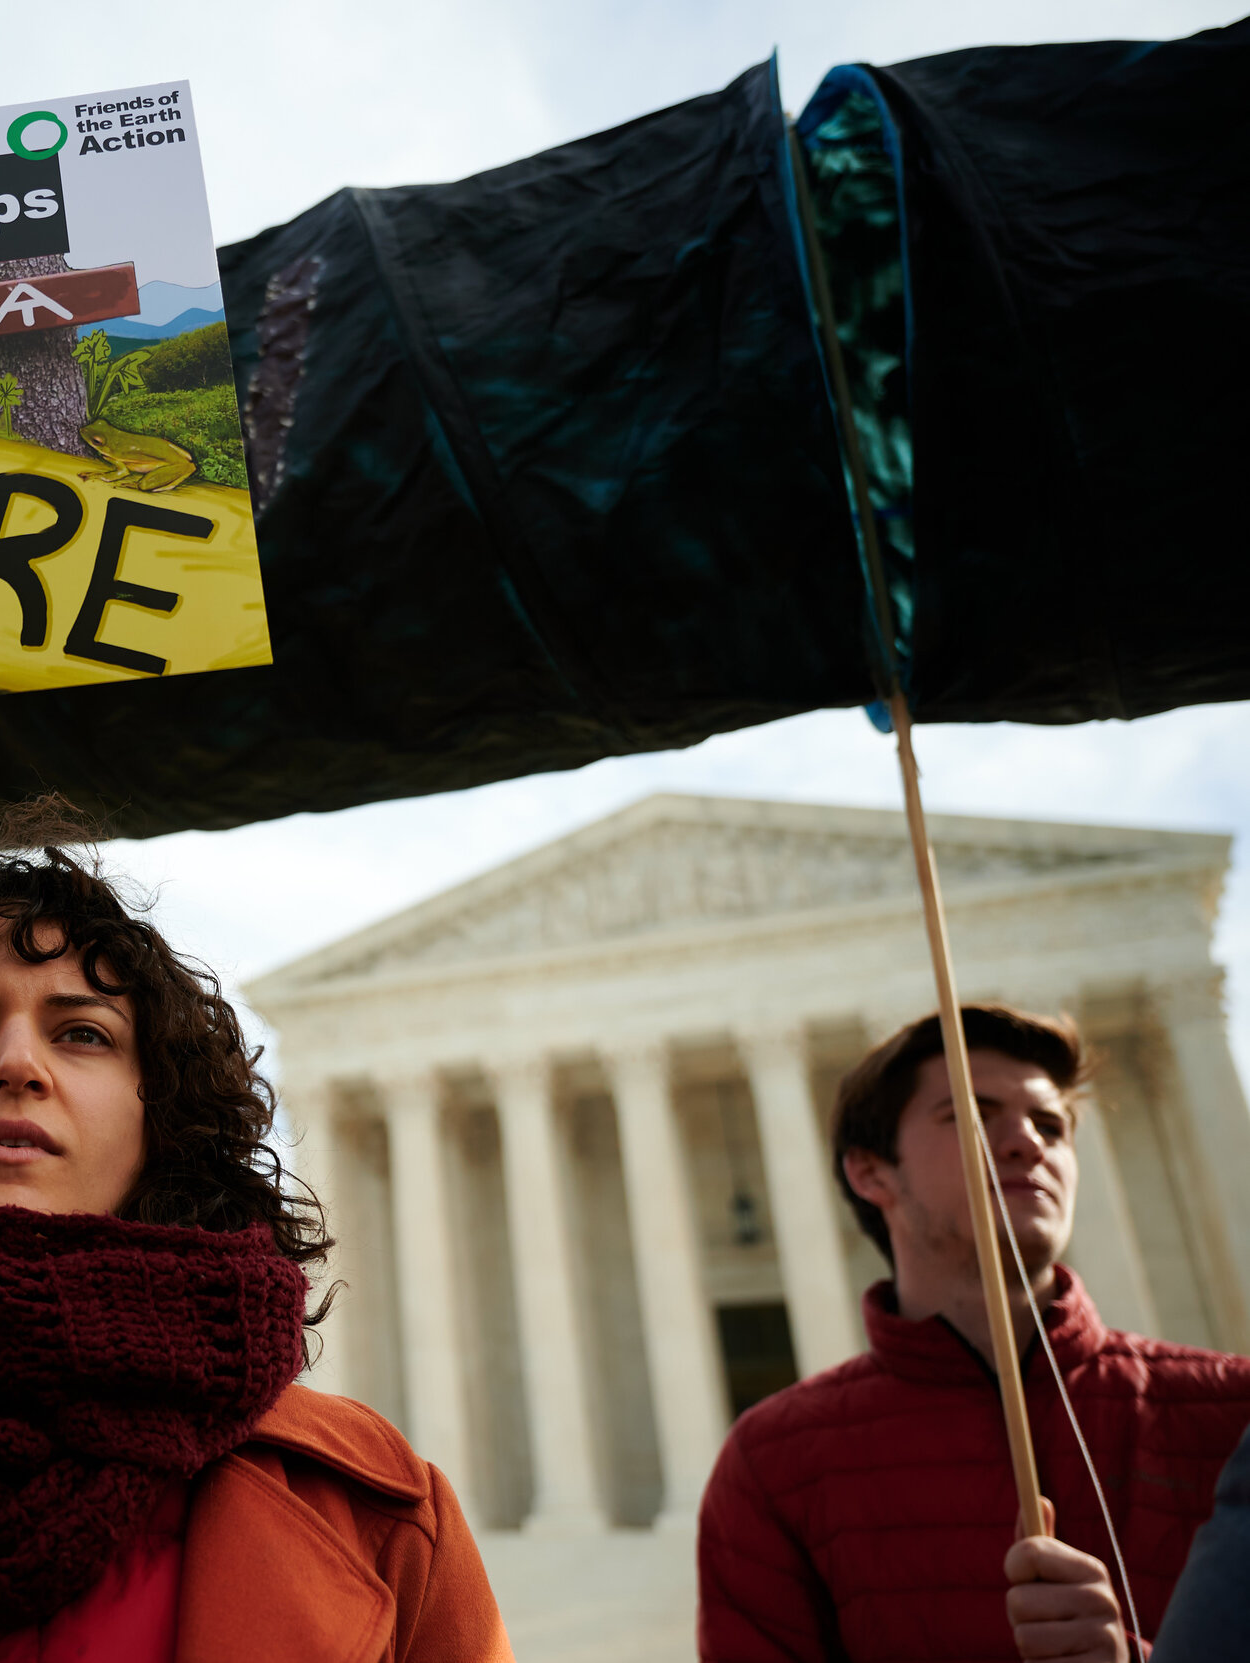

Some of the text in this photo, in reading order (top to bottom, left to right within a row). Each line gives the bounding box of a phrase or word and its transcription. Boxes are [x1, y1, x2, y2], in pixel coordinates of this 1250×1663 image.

[75, 90, 180, 118] Friends of
[76, 107, 182, 133] the Earth
[79, 127, 186, 156] Action
